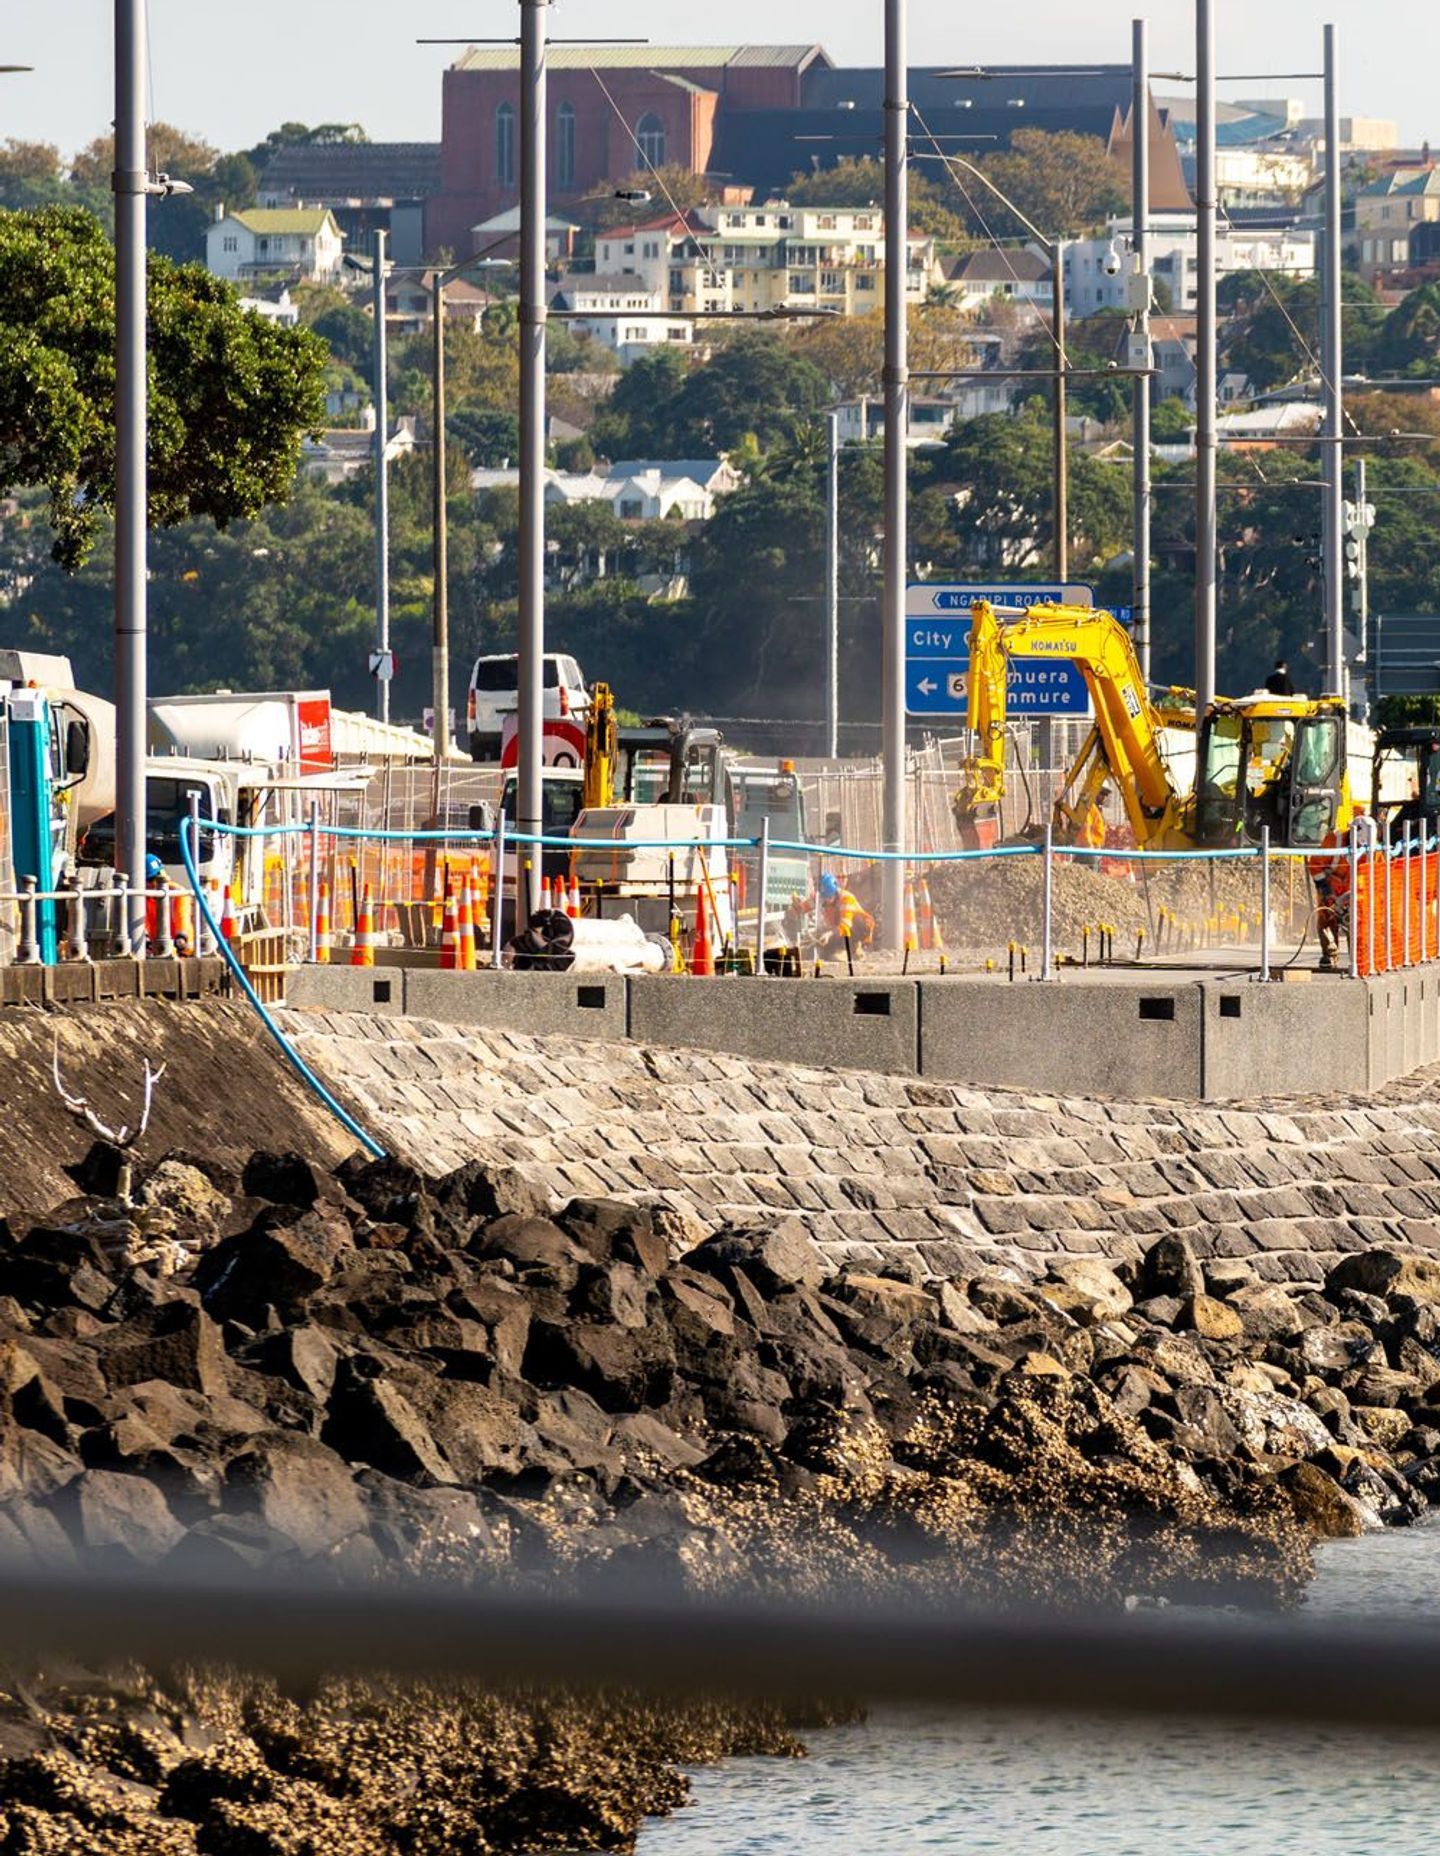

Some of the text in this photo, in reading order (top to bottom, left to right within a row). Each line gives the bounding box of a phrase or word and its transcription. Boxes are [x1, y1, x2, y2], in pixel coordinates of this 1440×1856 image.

[1015, 595, 1051, 606] ROAD
[913, 631, 952, 649] City
[1031, 640, 1077, 652] KOMATSU
[1007, 672, 1069, 684] muera
[1007, 691, 1071, 704] nmure
[1167, 719, 1197, 729] KOMA
